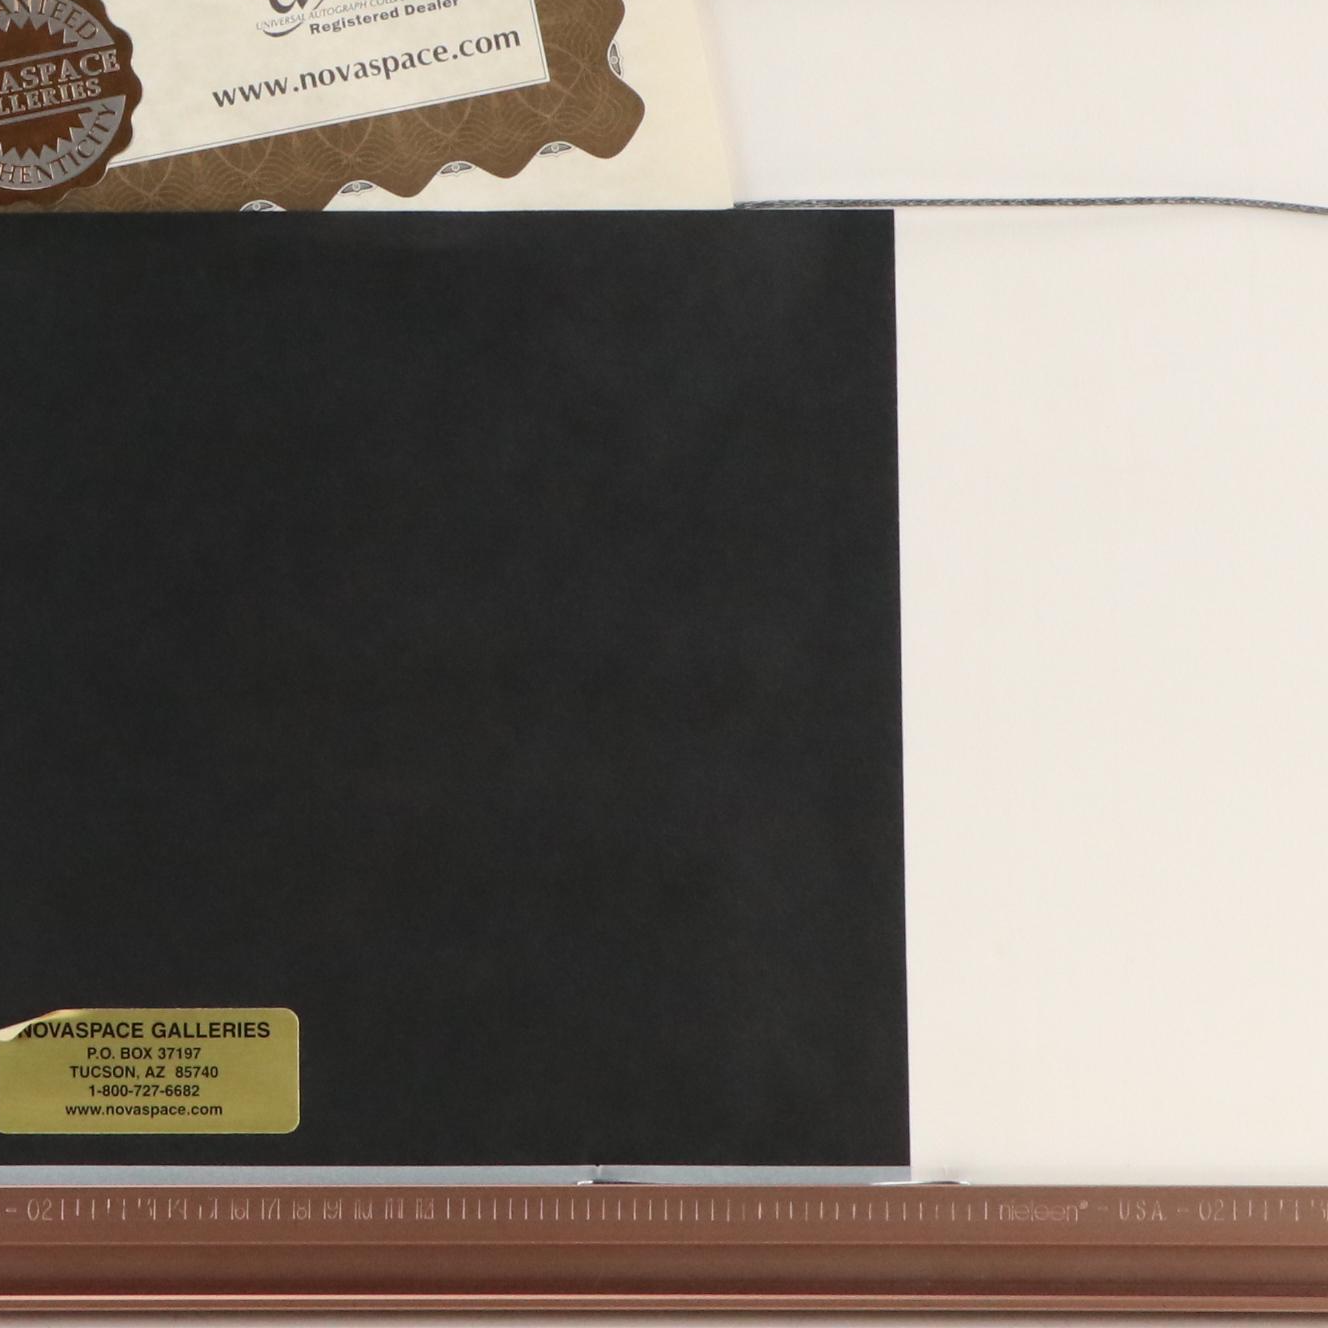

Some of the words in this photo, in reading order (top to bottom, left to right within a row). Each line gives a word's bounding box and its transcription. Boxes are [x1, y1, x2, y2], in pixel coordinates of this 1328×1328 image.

[256, 12, 306, 31] UNIVERSAL
[309, 0, 367, 20] AUTOGRAPH
[310, 7, 400, 36] Registered
[210, 29, 521, 108] www.novaspace.com
[151, 1022, 271, 1038] GALLERIES
[87, 1047, 115, 1060] P.O.
[120, 1047, 153, 1060] BOX
[158, 1047, 201, 1060] 37197
[70, 1066, 140, 1080] TUCSON,
[145, 1066, 166, 1078] AZ
[175, 1066, 219, 1078] 85740
[88, 1084, 200, 1097] 1-800-727-6682
[65, 1103, 223, 1118] www.novaspace.com
